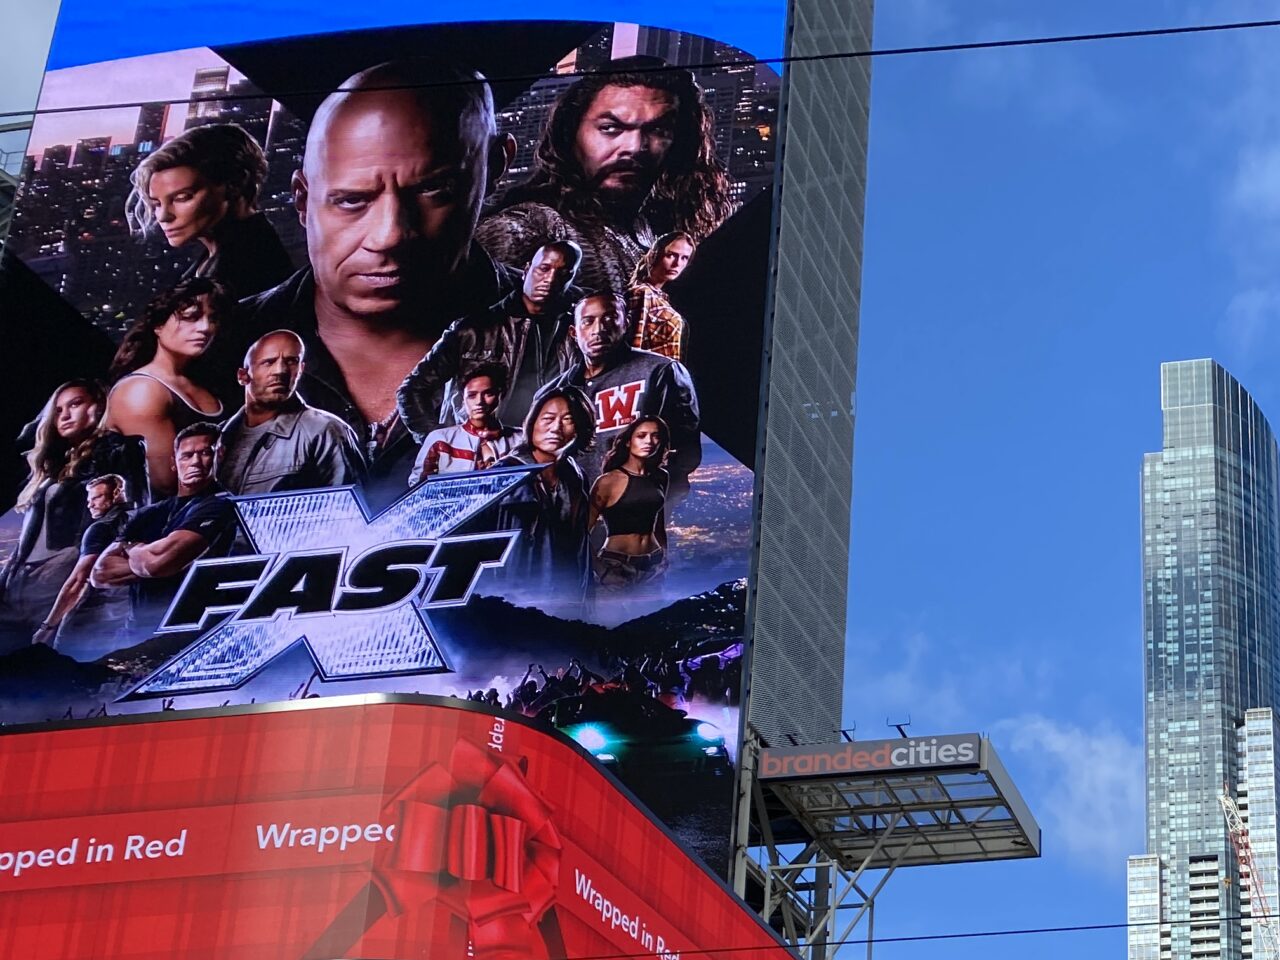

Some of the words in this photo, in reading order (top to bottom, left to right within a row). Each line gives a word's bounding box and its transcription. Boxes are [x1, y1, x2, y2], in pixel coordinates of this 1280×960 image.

[154, 528, 521, 635] FAST
[86, 838, 114, 863] in
[124, 829, 187, 861] Red
[574, 868, 639, 941] Wrapped
[641, 922, 653, 951] in
